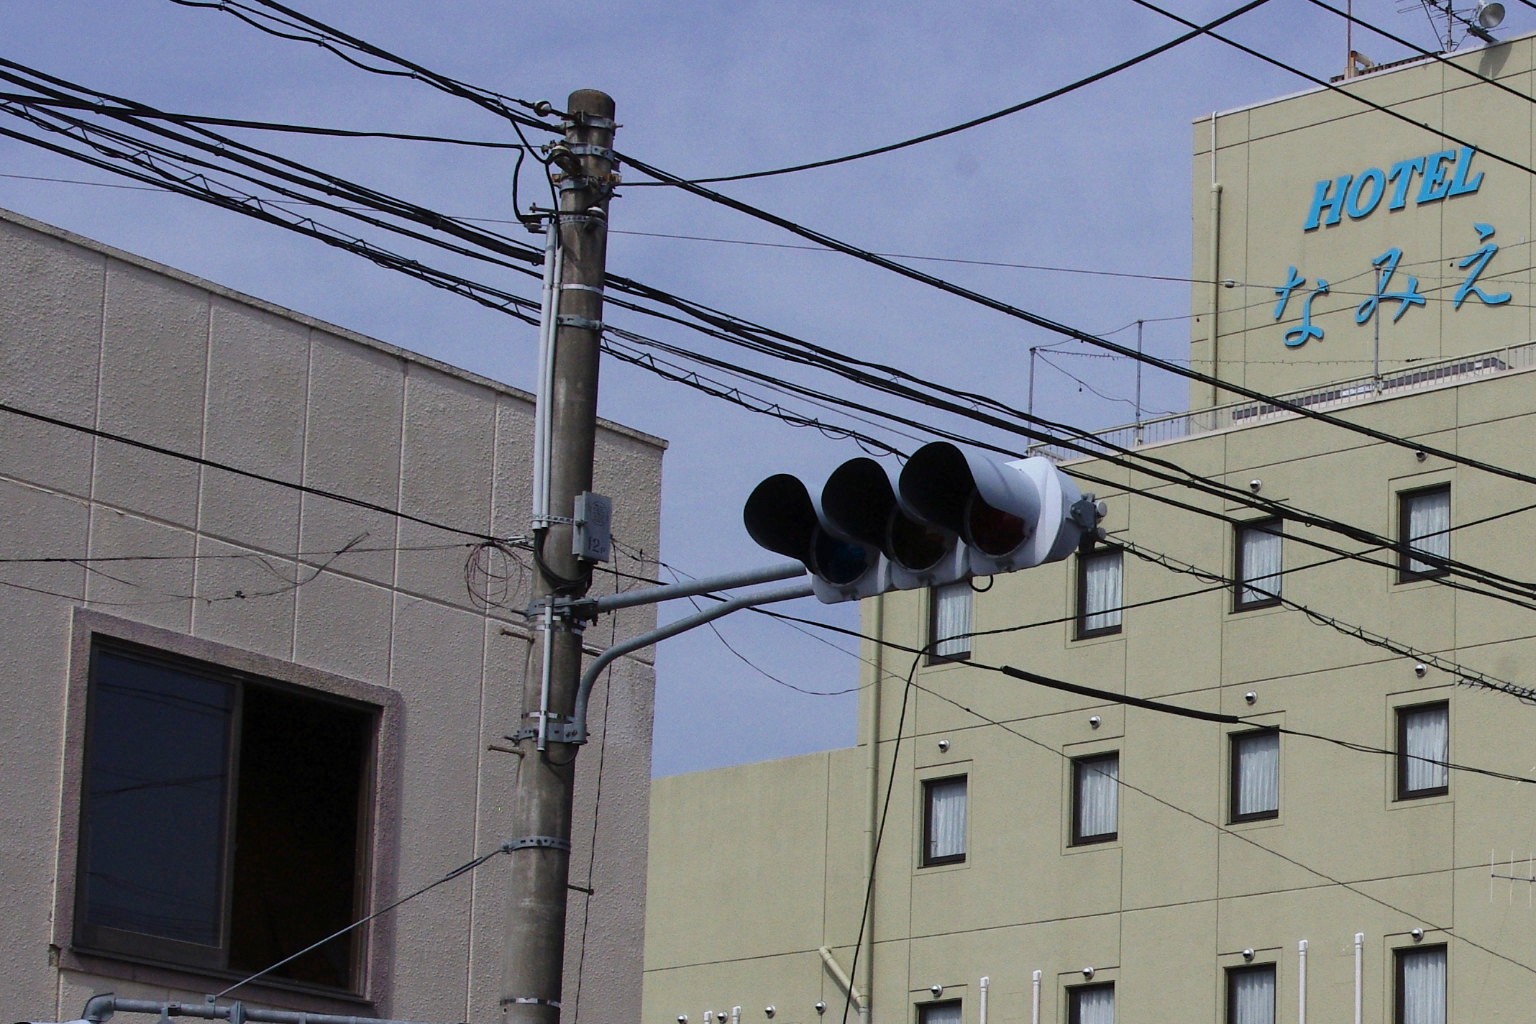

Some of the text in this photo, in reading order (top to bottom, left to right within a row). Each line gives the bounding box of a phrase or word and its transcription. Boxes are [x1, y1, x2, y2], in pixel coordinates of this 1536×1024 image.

[1303, 146, 1485, 232] HOTEL
[1273, 221, 1512, 348] なみえ
